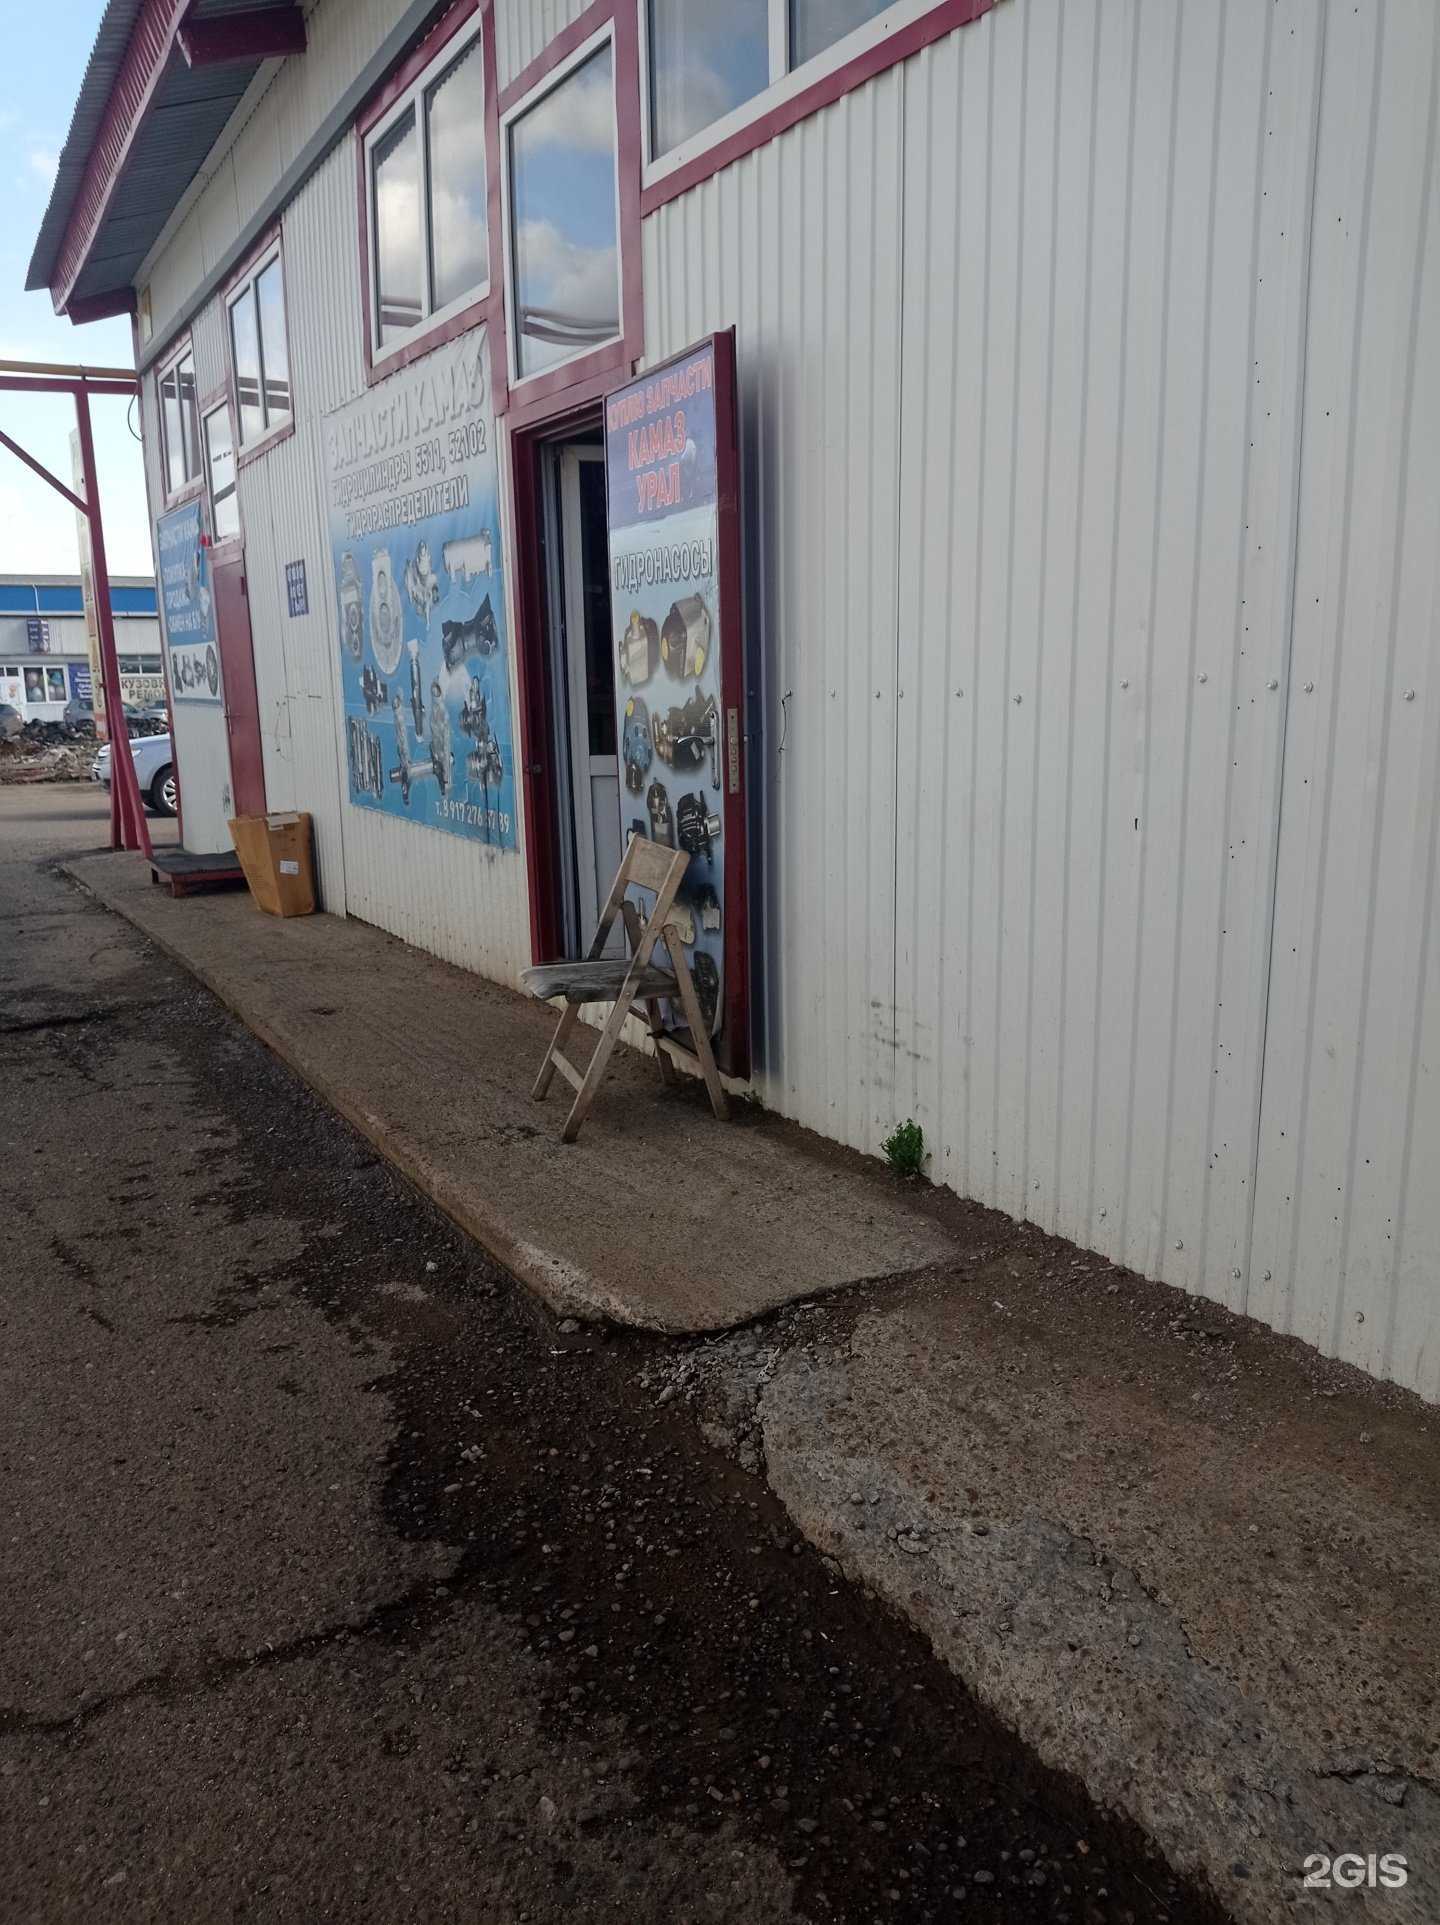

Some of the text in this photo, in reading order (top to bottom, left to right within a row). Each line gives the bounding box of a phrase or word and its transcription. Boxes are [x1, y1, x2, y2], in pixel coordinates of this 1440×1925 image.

[414, 354, 487, 437] КАМАЗ
[645, 354, 713, 415] ЗАПЧАСТИ
[332, 418, 488, 508] ГИДРОЦИЛИНДРЫ 5511, 52102
[627, 410, 687, 472] КАМАЗ
[344, 474, 471, 541] ГИДРОРАСПРЕДЕЛИТЕЛИ
[635, 462, 682, 513] УРАЛ
[613, 537, 713, 596] ГИДРОНАСОСЫ
